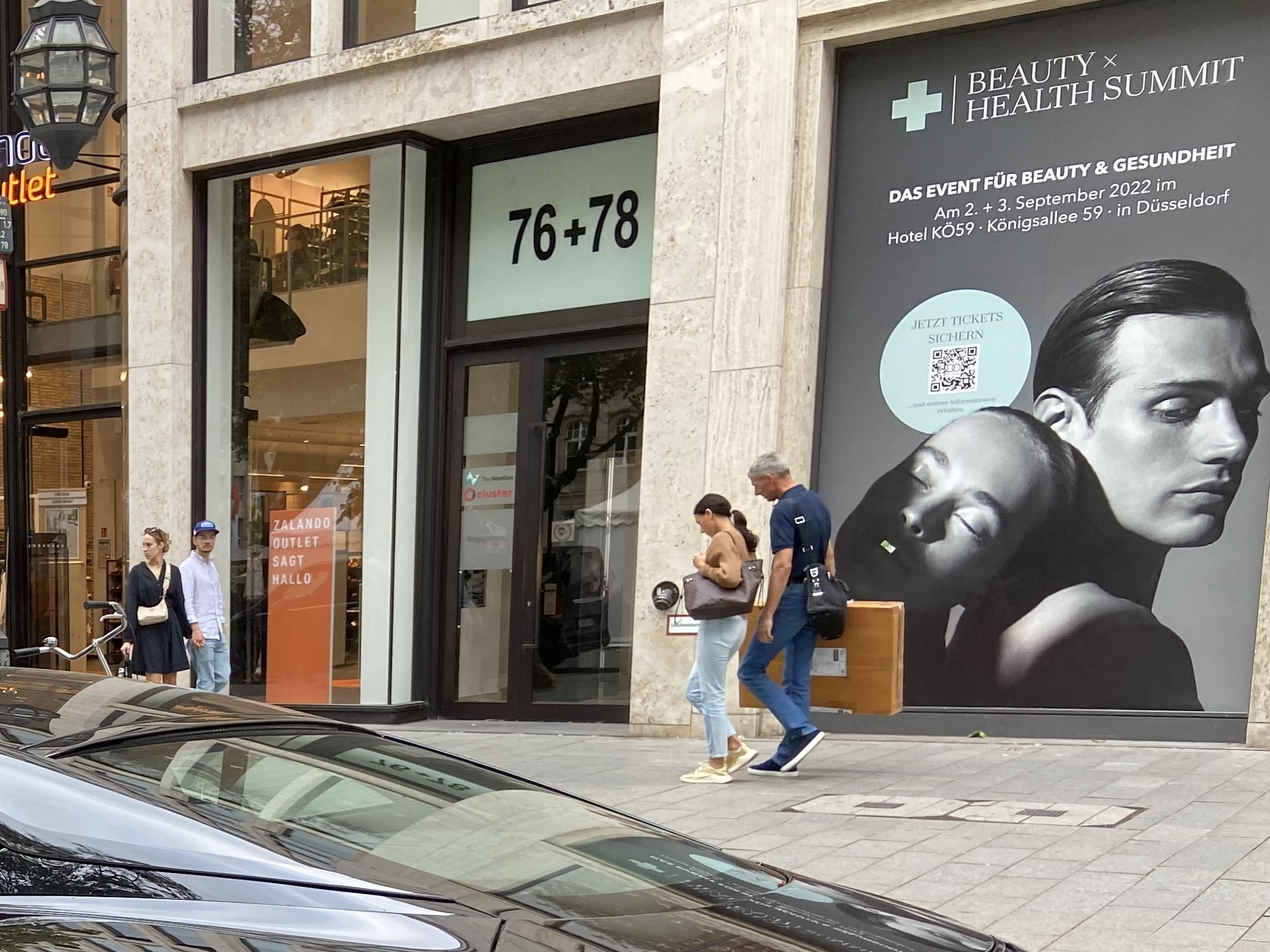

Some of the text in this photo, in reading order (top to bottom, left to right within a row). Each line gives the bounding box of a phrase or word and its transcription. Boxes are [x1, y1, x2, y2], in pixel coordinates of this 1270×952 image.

[967, 51, 1096, 96] BEAUTY
[966, 55, 1245, 124] HEALTH SUMMIT
[888, 142, 1236, 204] DAS EVENT FÜR BEAUTY & GESUNDHEIT
[934, 178, 1177, 221] Am 2. + 3. September 2022 im
[508, 189, 639, 265] 76+78
[887, 188, 1231, 246] Hotel KÖ59 Königsallee 59 in Düsseldorf
[910, 311, 1004, 331] JETZT TICKETS
[927, 329, 985, 344] SICHERN
[273, 516, 331, 531] ZALANDO
[273, 536, 319, 549] OUTLET
[272, 555, 305, 568] SAGT
[272, 573, 311, 585] HALLO
